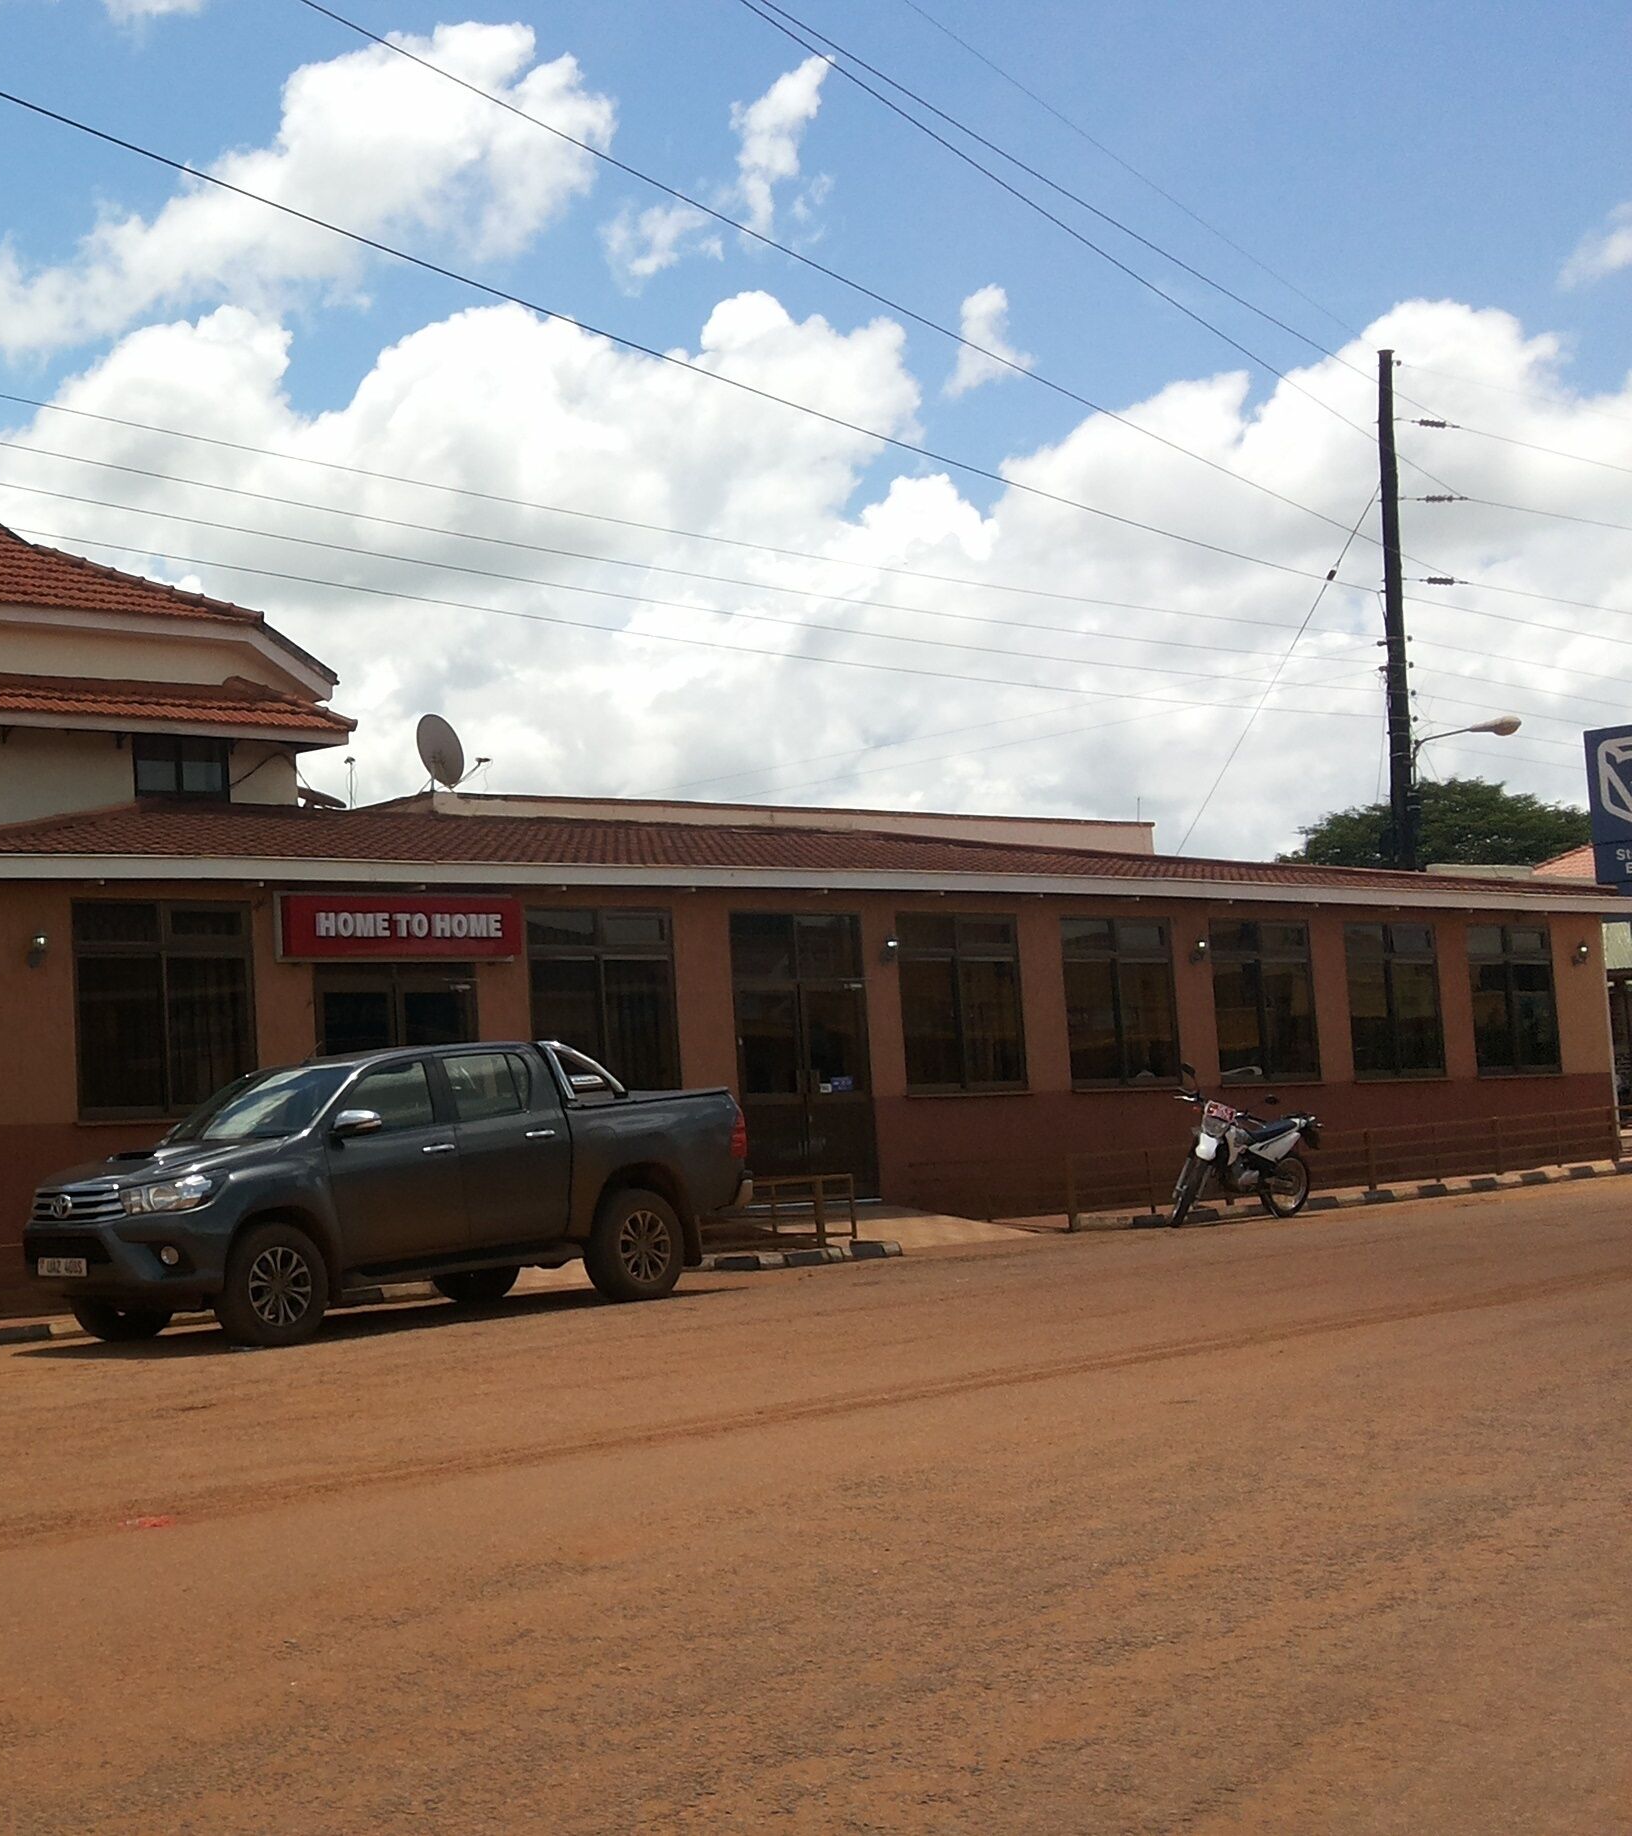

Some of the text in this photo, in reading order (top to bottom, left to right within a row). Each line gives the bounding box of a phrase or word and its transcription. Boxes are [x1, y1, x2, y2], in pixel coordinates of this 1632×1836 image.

[316, 912, 503, 938] HOME TO HOME
